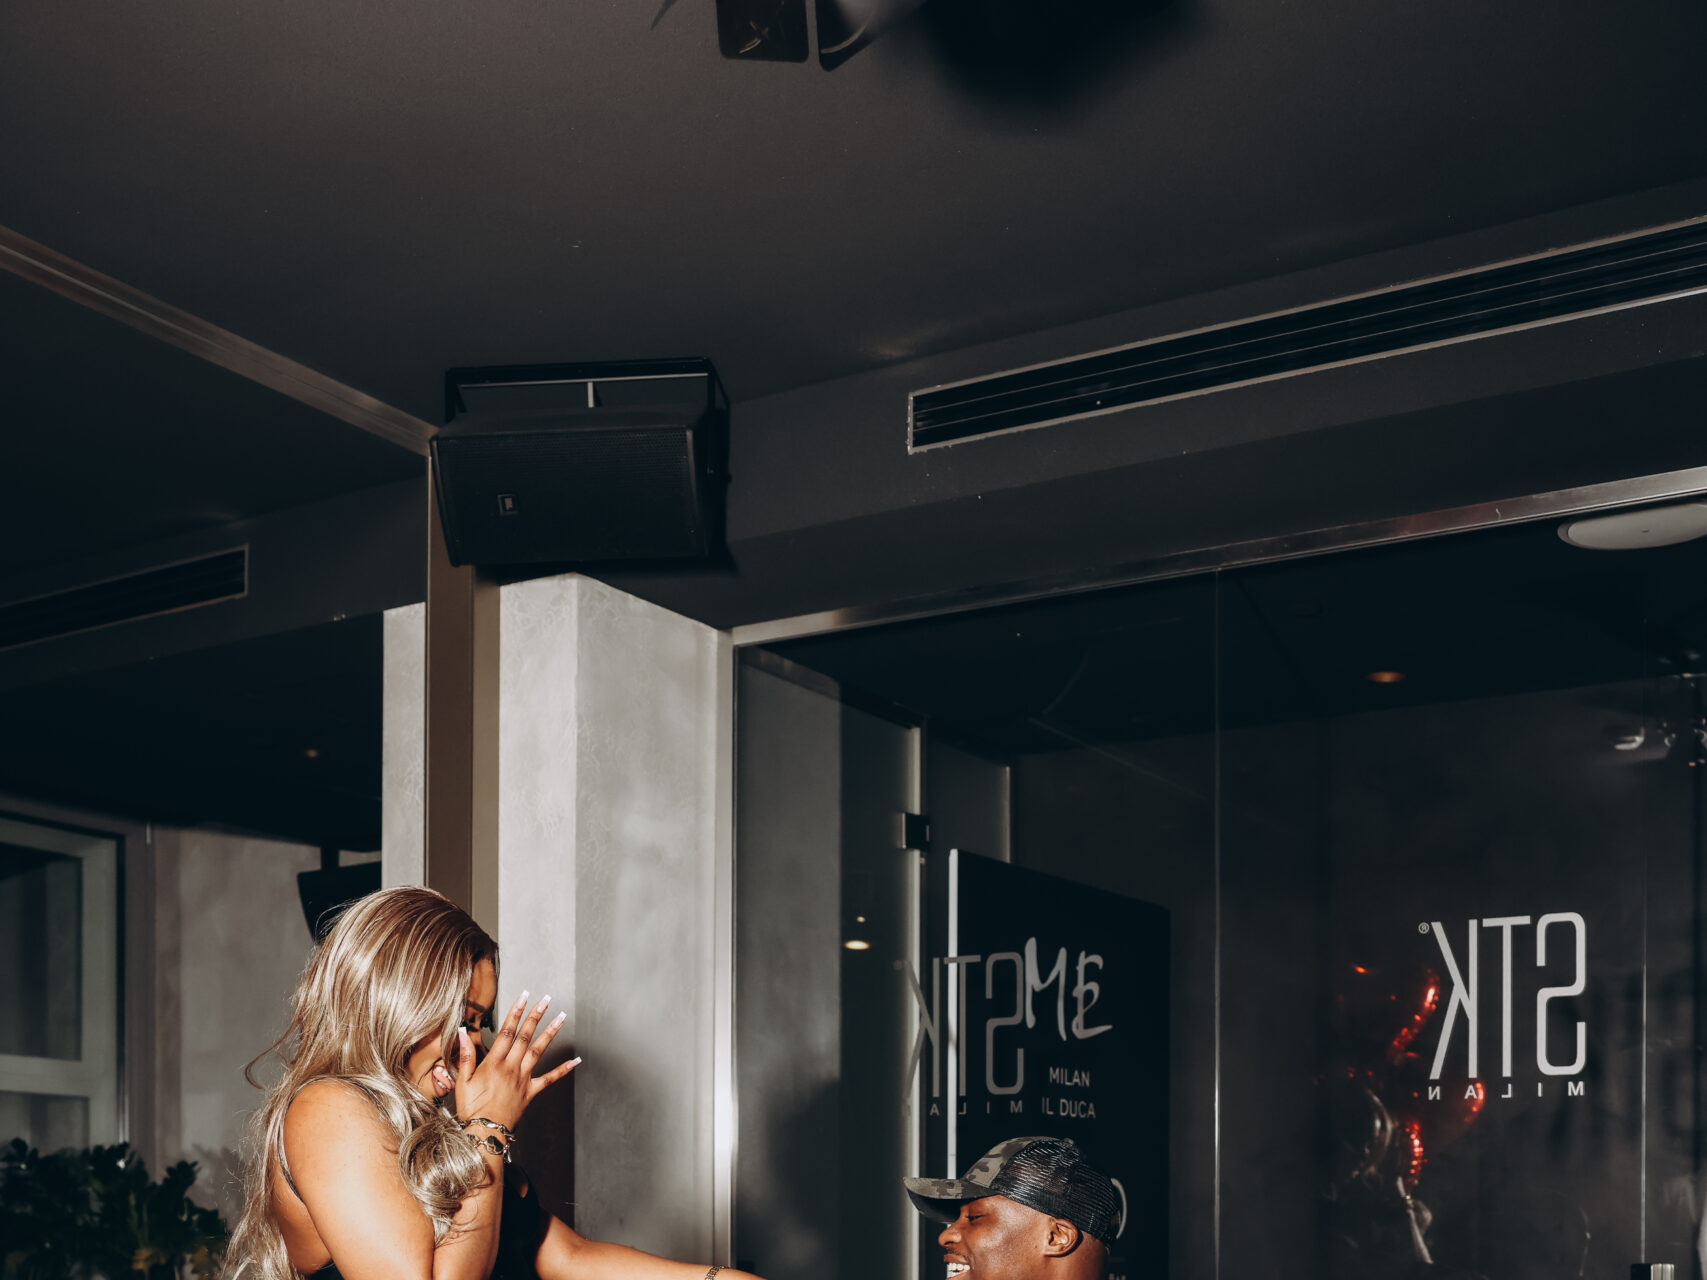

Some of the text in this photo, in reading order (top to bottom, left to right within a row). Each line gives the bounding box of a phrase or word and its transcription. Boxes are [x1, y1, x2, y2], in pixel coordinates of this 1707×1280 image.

[1024, 936, 1112, 1042] ME
[1049, 1066, 1091, 1088] MILAN
[1041, 1097, 1096, 1119] IL DUCA
